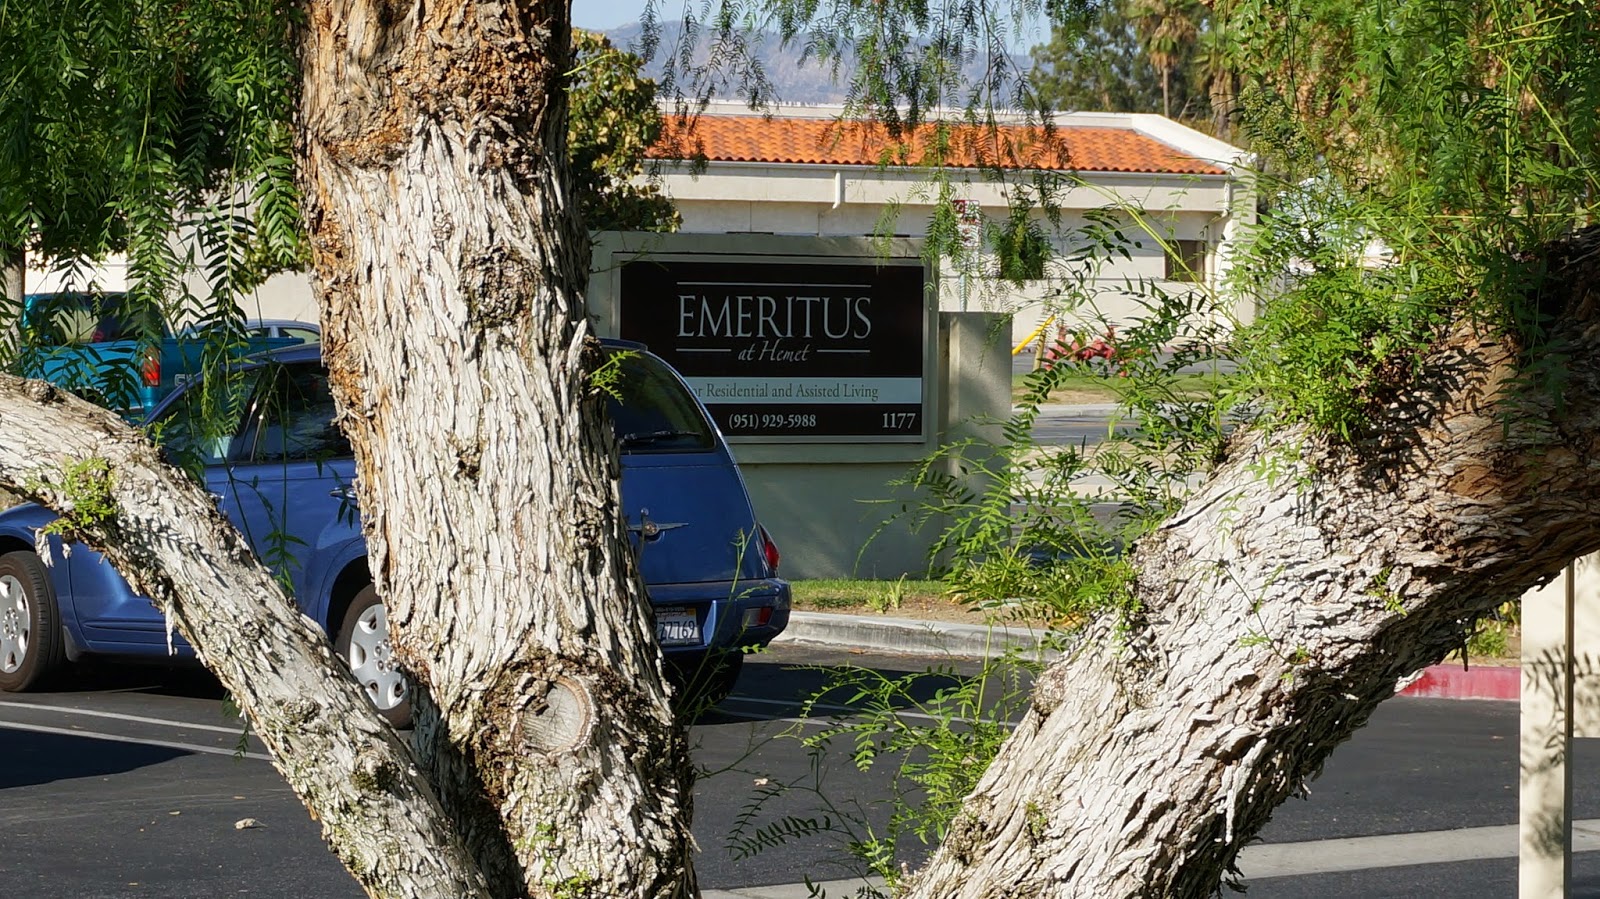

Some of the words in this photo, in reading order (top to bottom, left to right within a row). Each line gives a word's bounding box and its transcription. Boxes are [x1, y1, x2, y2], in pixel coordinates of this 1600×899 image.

[676, 294, 872, 339] EMERITUS
[737, 346, 755, 362] at
[758, 338, 811, 362] Hemet
[706, 383, 768, 398] Residential
[771, 383, 793, 398] and
[796, 383, 840, 399] Assisted
[843, 383, 879, 402] Living
[728, 413, 760, 430] (951)
[762, 414, 817, 429] 929-5988
[881, 412, 916, 430] 1177
